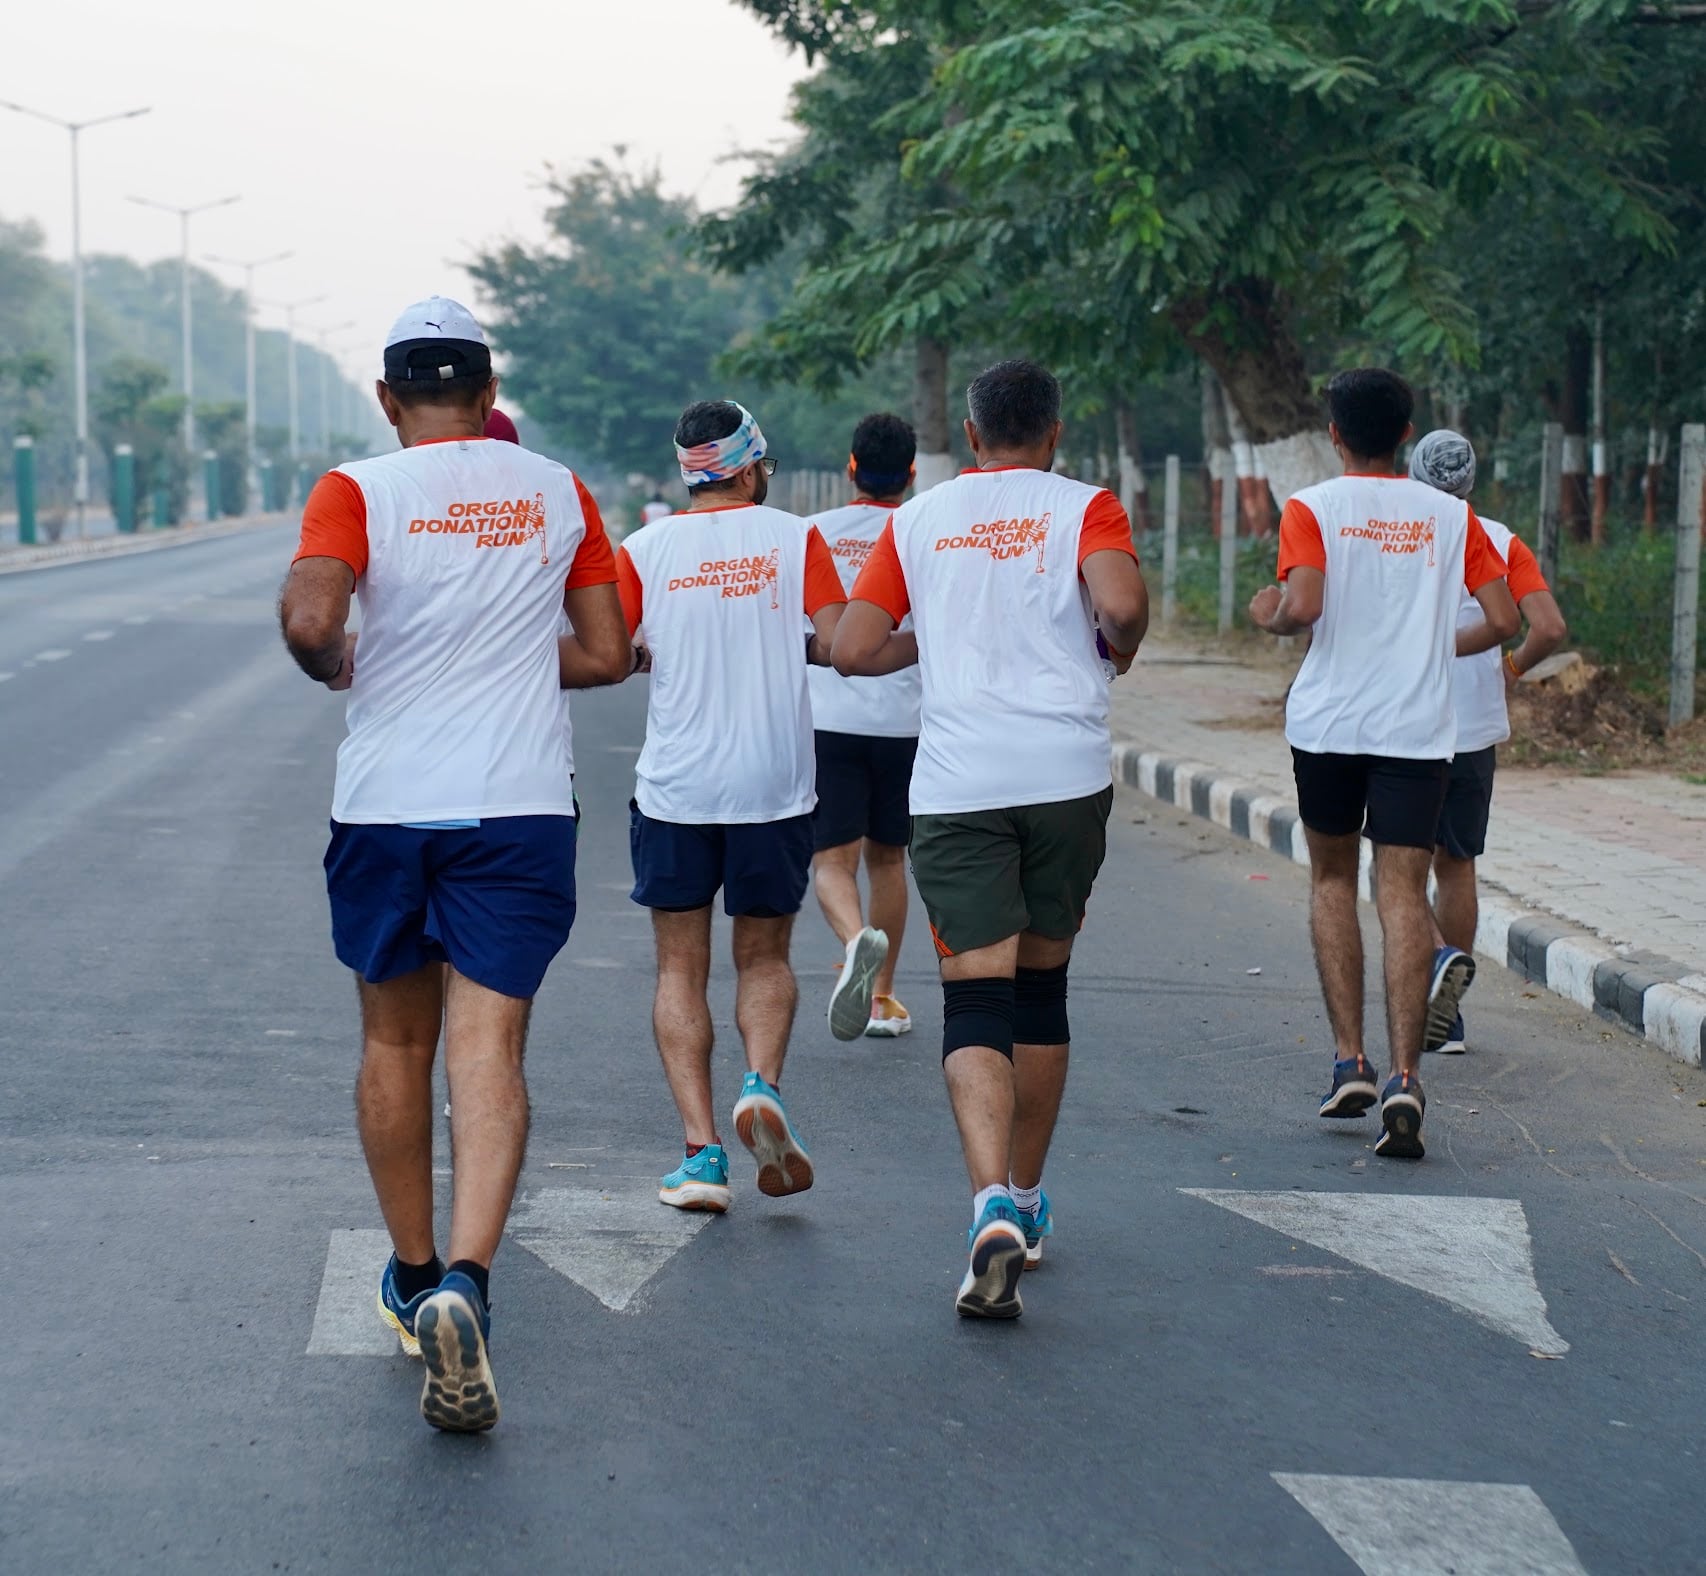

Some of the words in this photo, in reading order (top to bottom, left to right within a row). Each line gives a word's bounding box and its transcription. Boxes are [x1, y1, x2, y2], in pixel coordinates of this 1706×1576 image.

[448, 499, 531, 518] ORGAN
[408, 515, 528, 534] DONATION
[971, 518, 1035, 535] ORGAN
[1367, 518, 1424, 532] ORGAN
[476, 531, 525, 549] RUN
[935, 532, 1028, 551] DONAION
[1340, 527, 1421, 543] DONATION
[836, 538, 877, 550] ORGA
[991, 545, 1024, 560] RUN
[1381, 543, 1418, 554] RUN
[700, 556, 766, 573] ORGAN
[668, 569, 761, 592] DONATION
[721, 583, 760, 598] RUN
